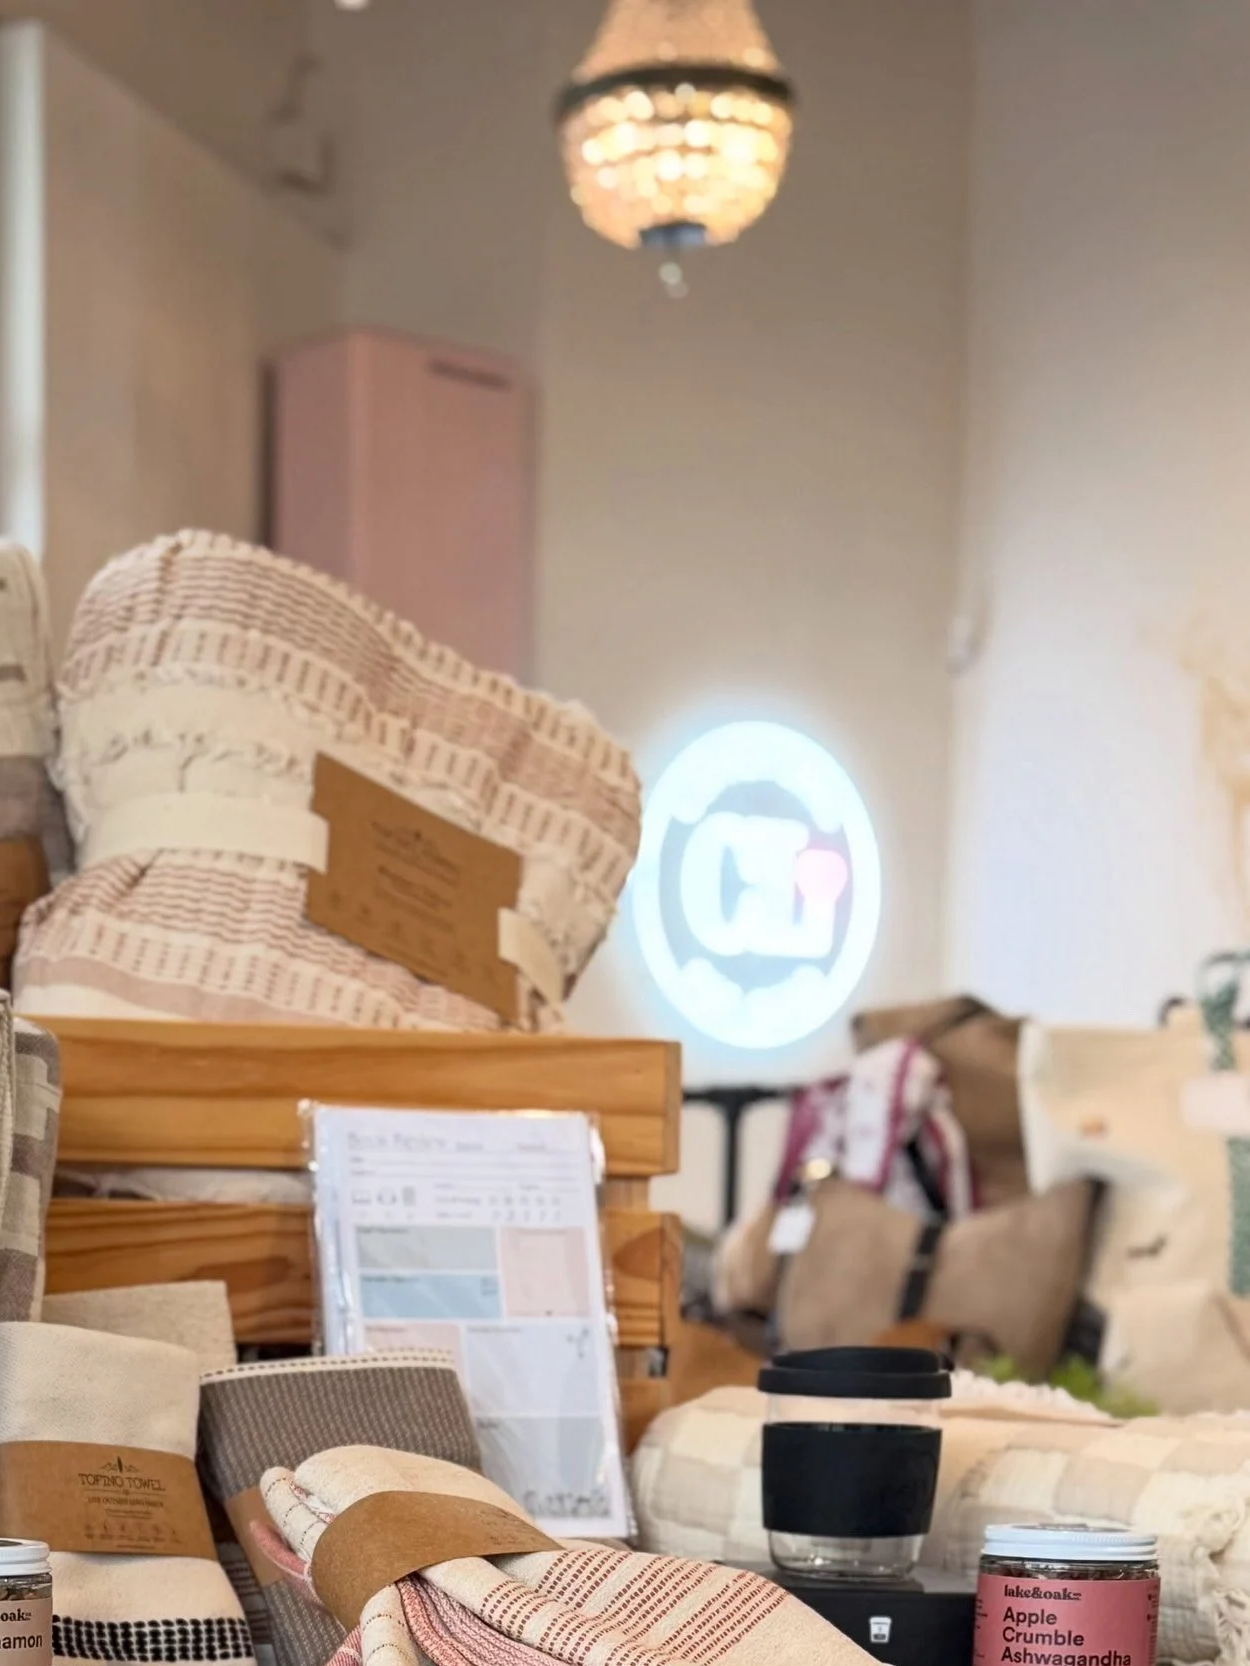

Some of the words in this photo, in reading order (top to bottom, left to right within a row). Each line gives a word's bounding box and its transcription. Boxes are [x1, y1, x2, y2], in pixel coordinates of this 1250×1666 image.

[78, 1473, 124, 1488] TOFINO
[125, 1477, 166, 1491] TOWEL
[1004, 1584, 1073, 1600] lake&oak
[1003, 1606, 1057, 1628] Apple
[1002, 1626, 1085, 1646] Crumble
